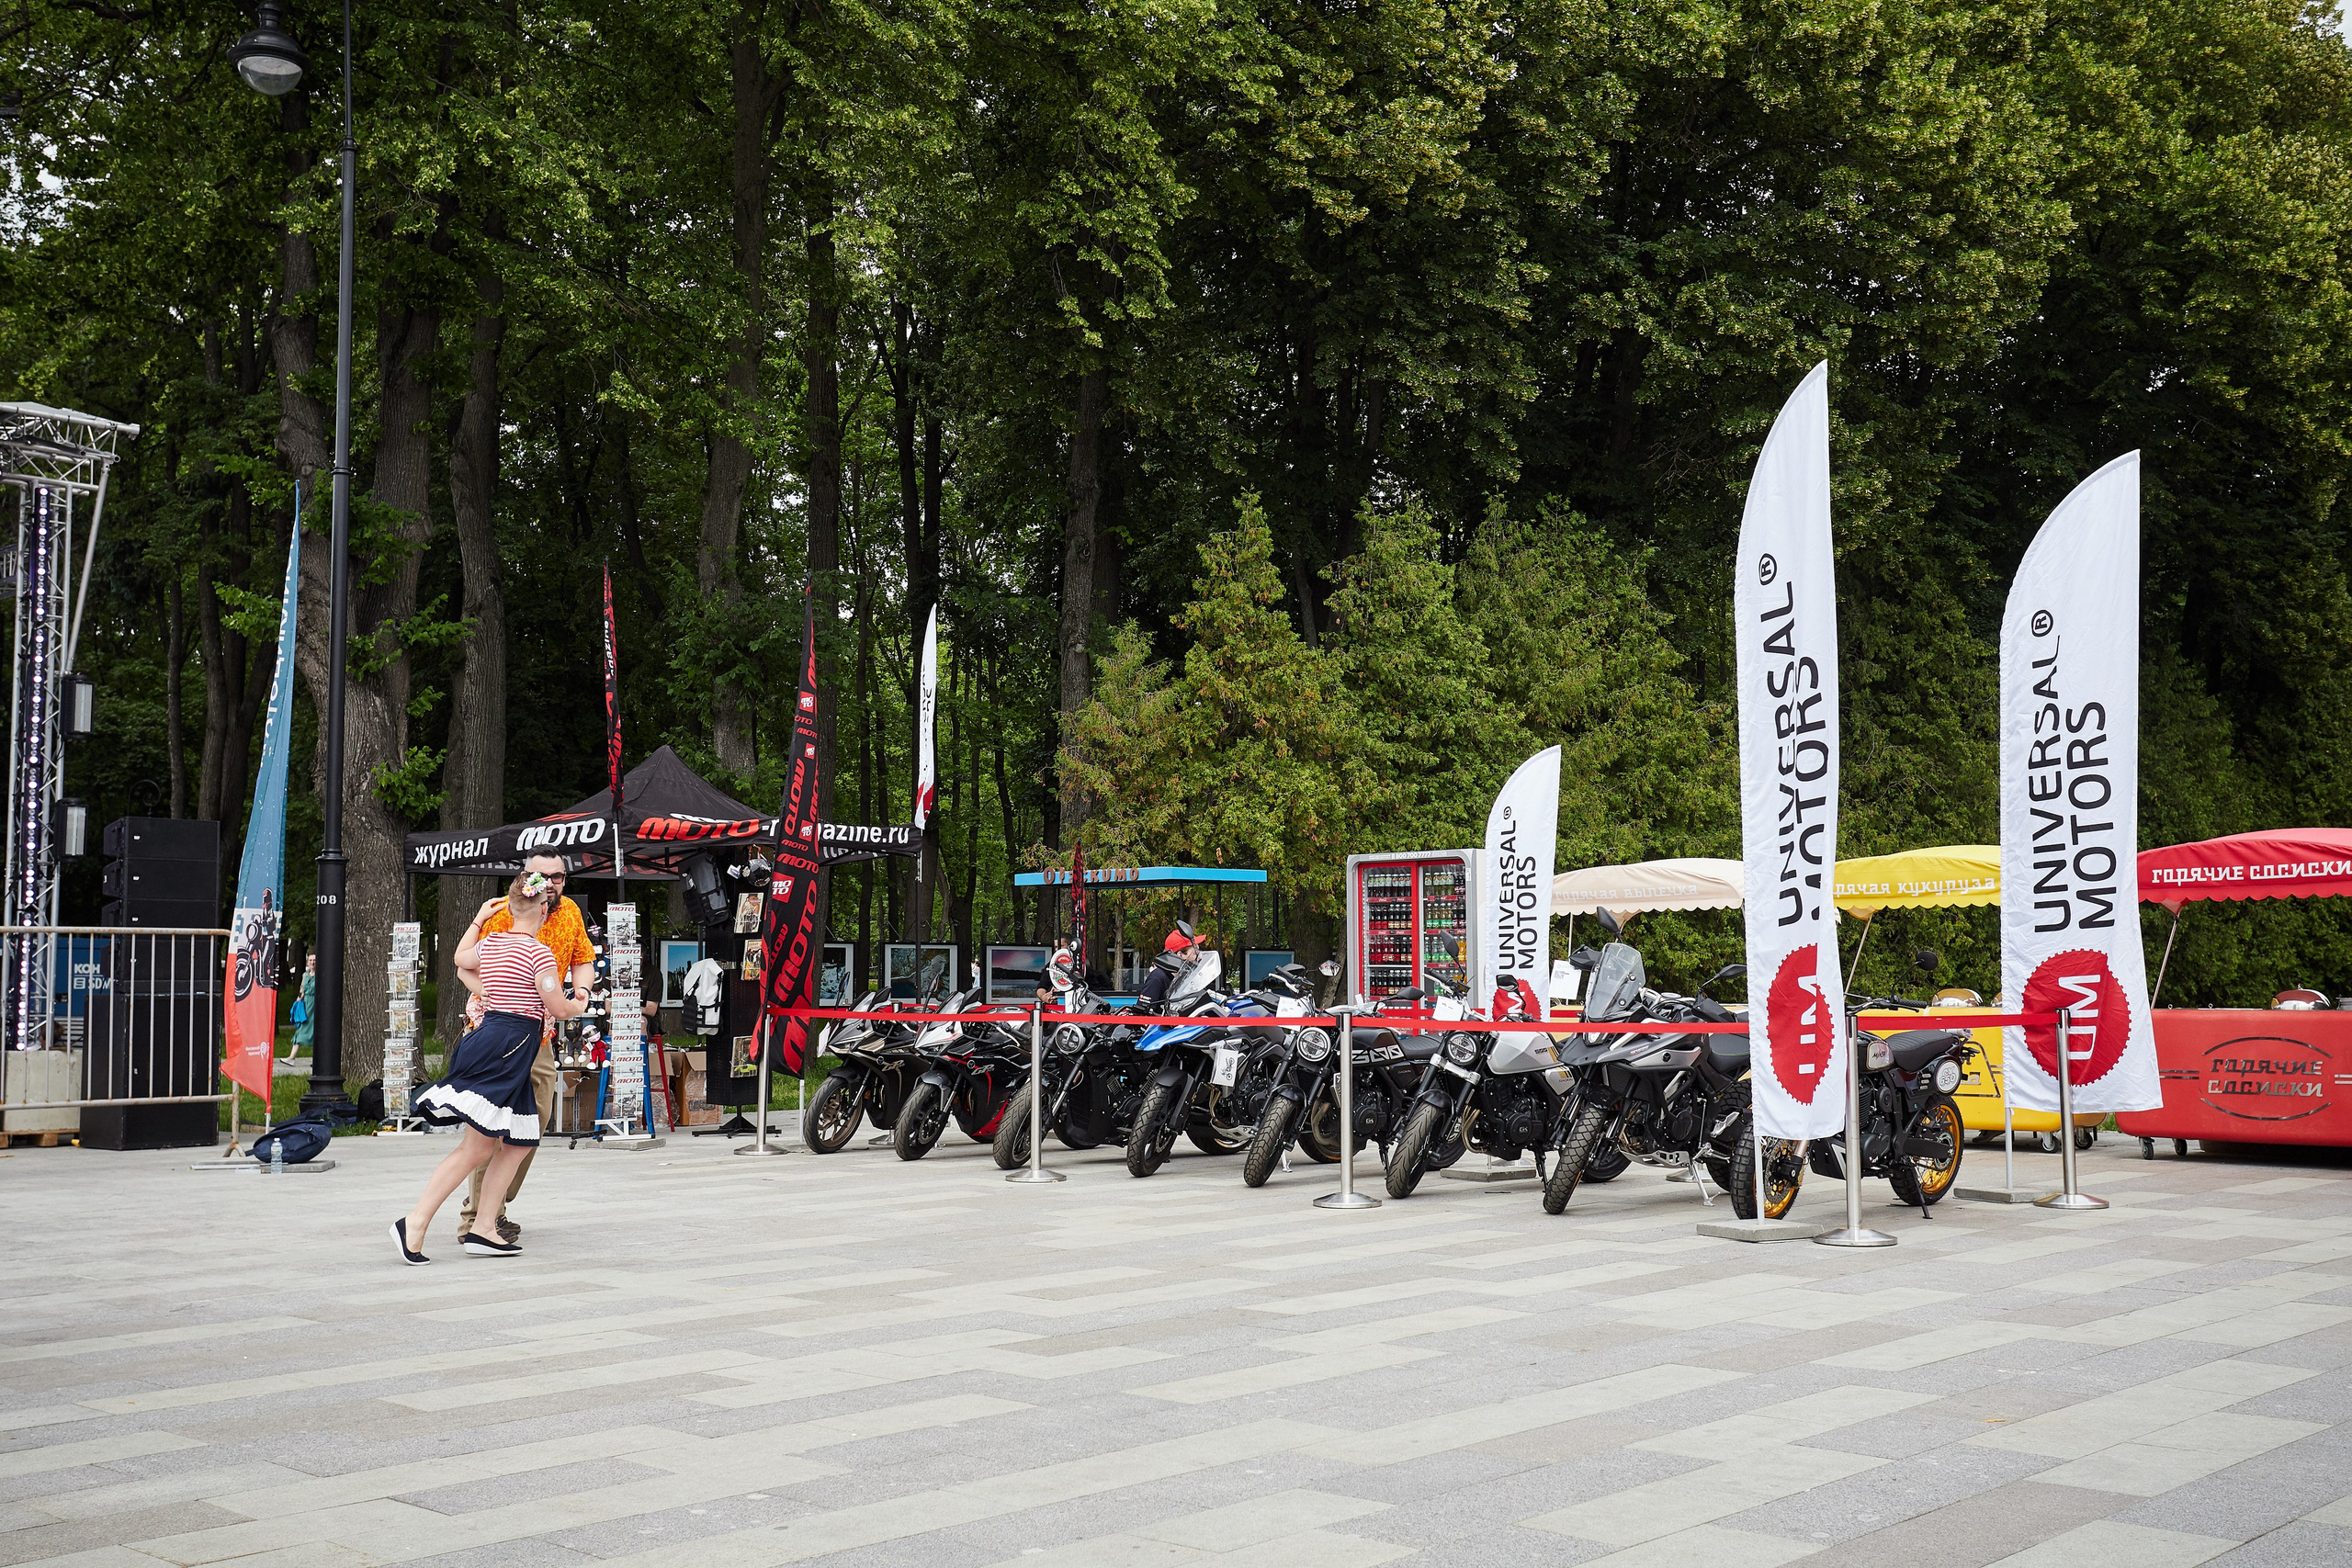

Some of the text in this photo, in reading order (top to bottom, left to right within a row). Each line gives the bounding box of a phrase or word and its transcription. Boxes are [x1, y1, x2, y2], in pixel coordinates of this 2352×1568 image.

[794, 715, 813, 725] OTO
[1760, 581, 1803, 926] UNIVERSAL
[785, 758, 805, 836] MOTO
[2029, 635, 2071, 932] UNIVERSAL
[2066, 702, 2117, 929] MOTORS
[413, 837, 489, 868] журнал
[776, 853, 819, 874] MOTO
[781, 839, 808, 852] MOTO
[1498, 820, 1516, 970] UNIVERSAL
[1517, 856, 1538, 969] MOTORS
[1833, 883, 1891, 897] рячая
[775, 880, 817, 1002] MOTO
[2057, 975, 2101, 1060] UM
[1939, 1073, 1957, 1087] 650
